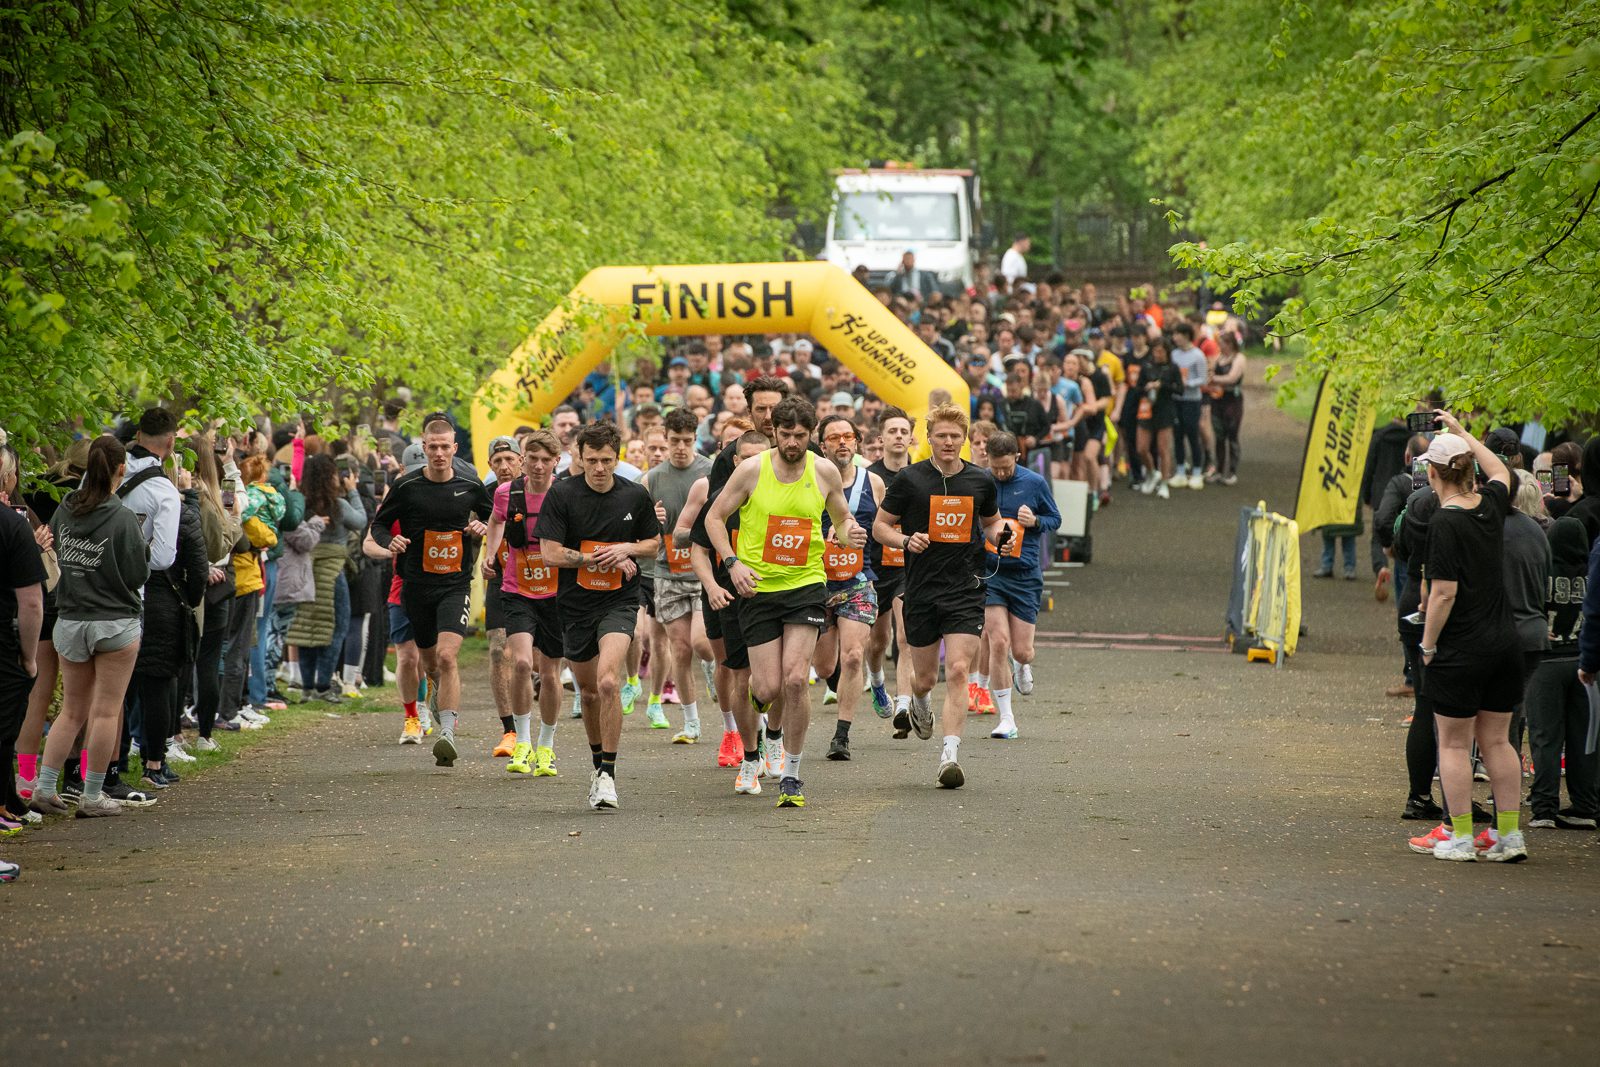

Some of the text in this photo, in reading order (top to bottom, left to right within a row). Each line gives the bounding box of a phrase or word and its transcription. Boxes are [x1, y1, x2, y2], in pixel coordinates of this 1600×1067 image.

[632, 281, 793, 320] FINISH
[867, 330, 917, 370] UP AND
[851, 336, 915, 385] RUNNING
[1325, 420, 1338, 451] UP
[935, 512, 967, 527] 507
[771, 533, 805, 550] 687
[58, 544, 103, 567] Attitude
[428, 546, 458, 559] 643
[671, 547, 692, 561] 78
[828, 552, 858, 567] 539
[523, 566, 552, 580] 581
[1545, 576, 1589, 604] 199
